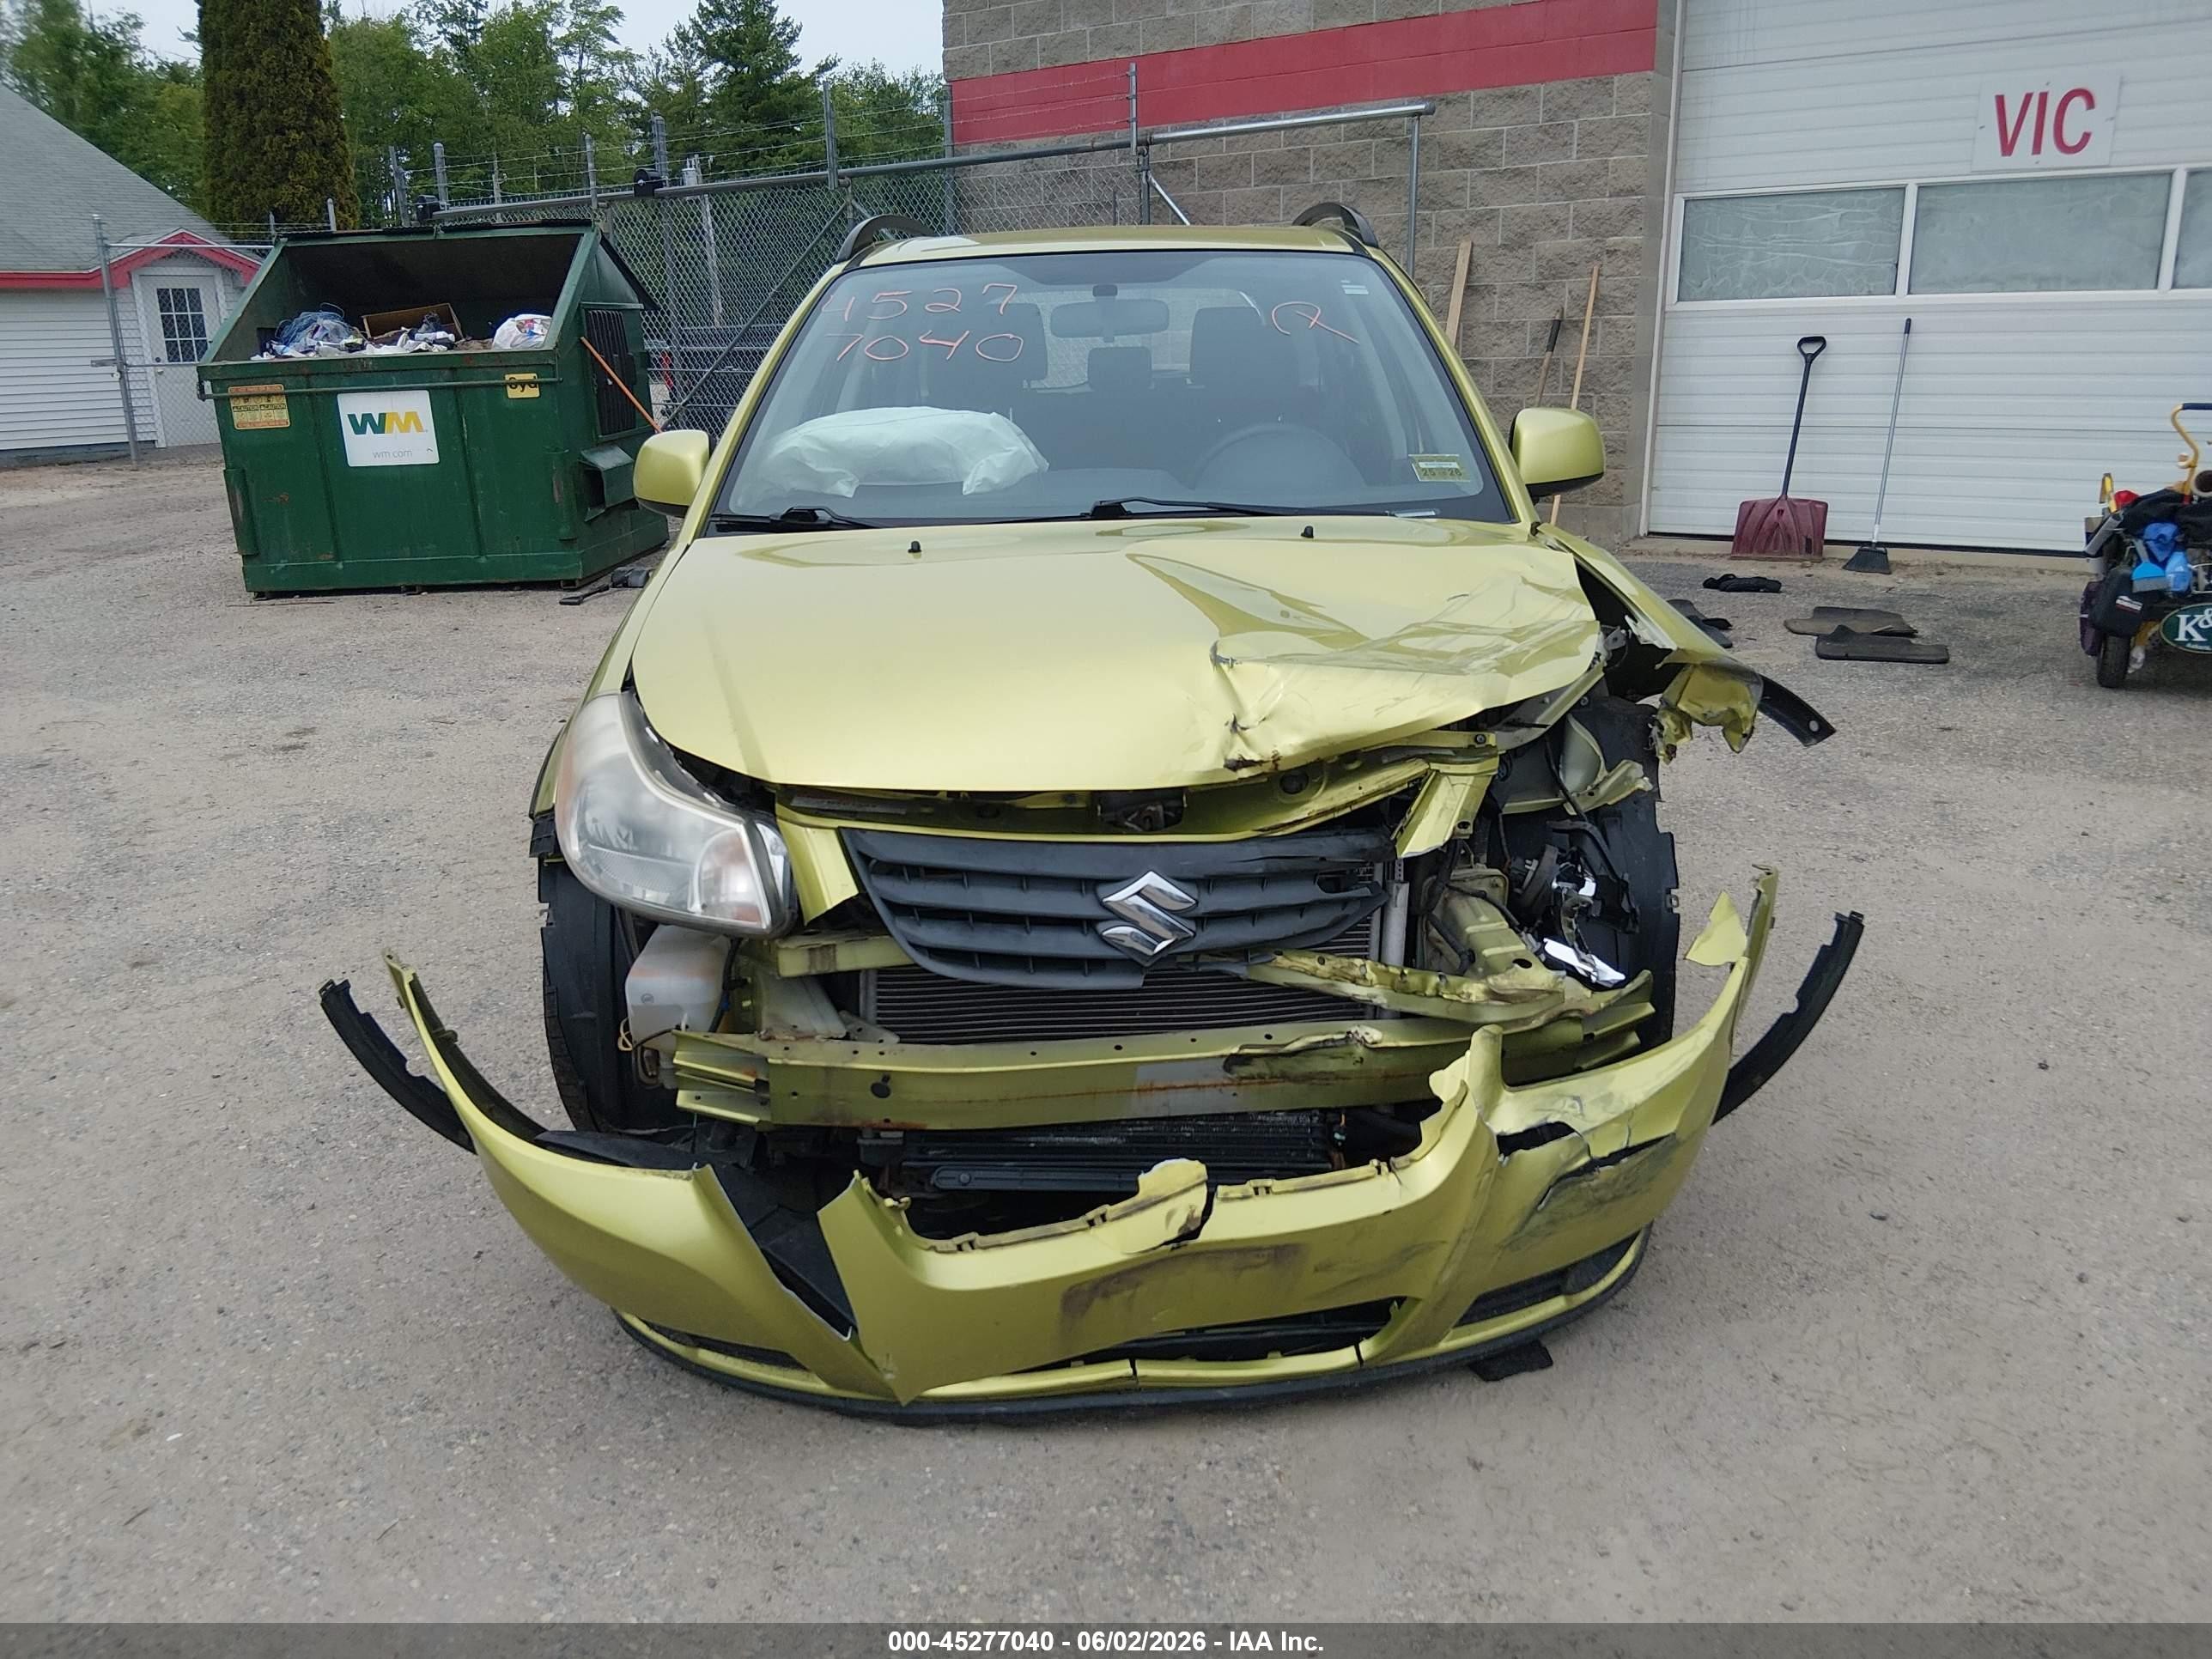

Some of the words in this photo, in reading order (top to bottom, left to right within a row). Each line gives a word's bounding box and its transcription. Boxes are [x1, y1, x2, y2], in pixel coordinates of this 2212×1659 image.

[1995, 88, 2095, 156] VIC
[821, 283, 1018, 322] 4527
[824, 330, 1024, 362] 7040
[347, 411, 424, 435] WM
